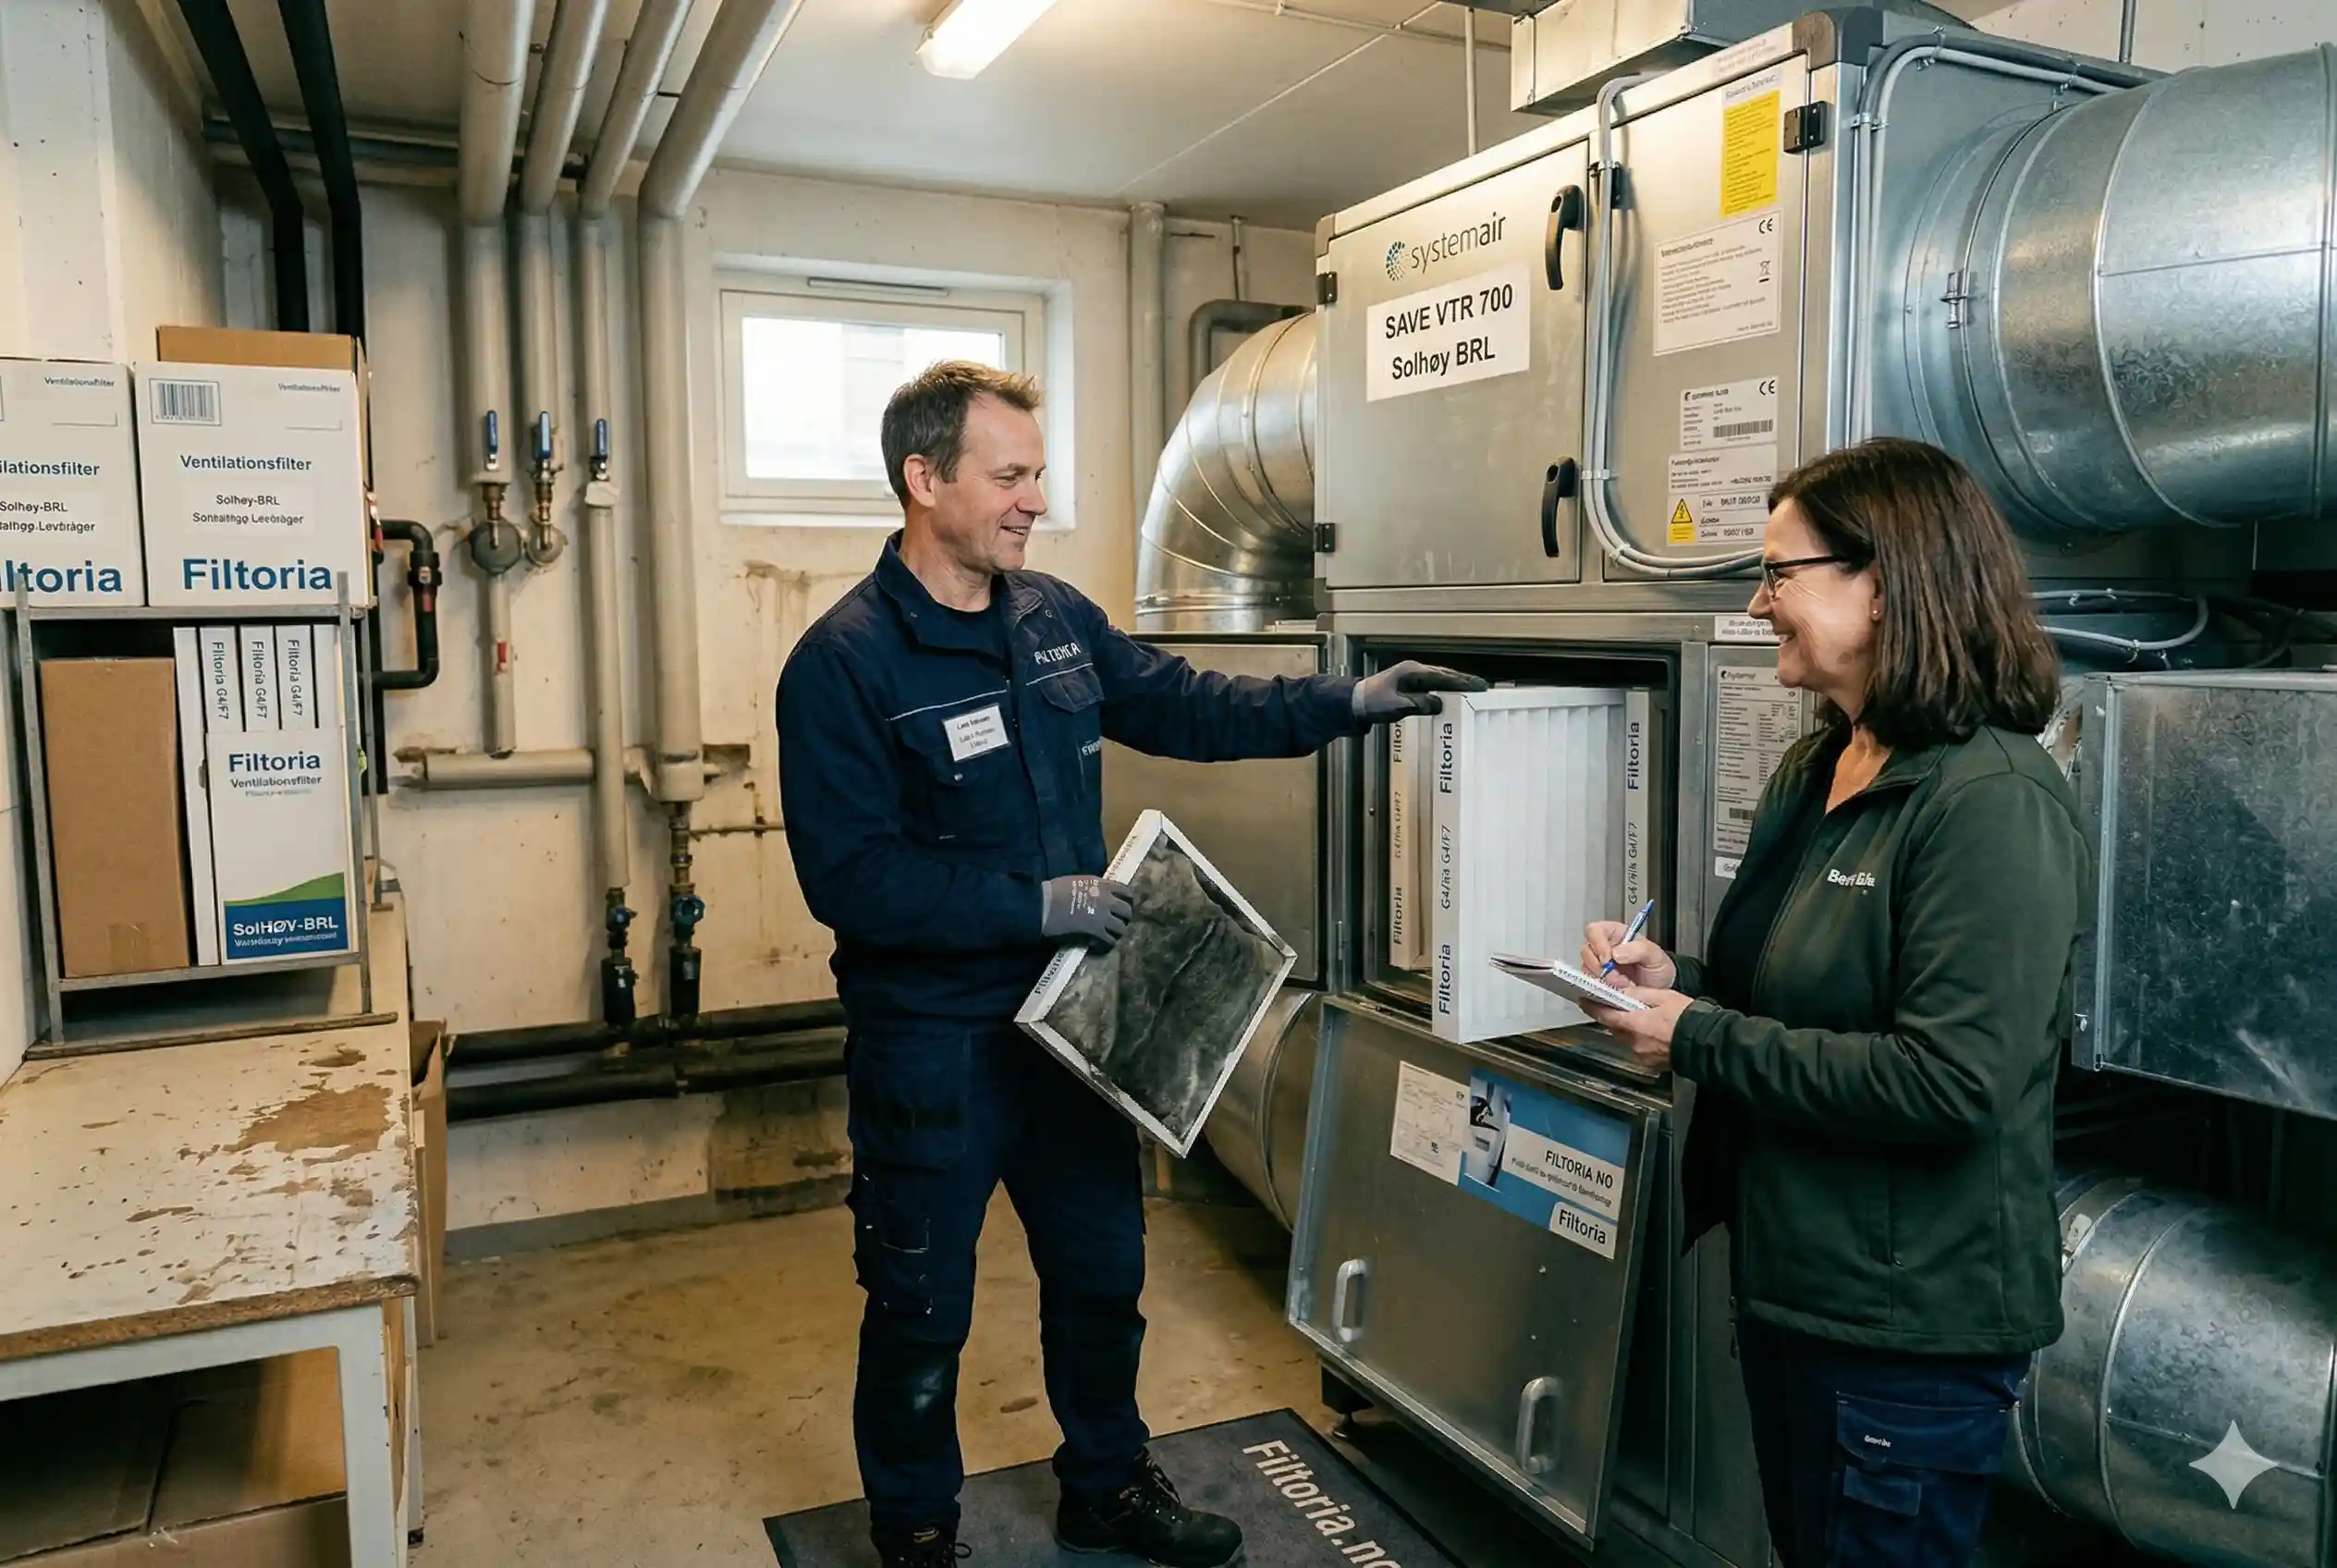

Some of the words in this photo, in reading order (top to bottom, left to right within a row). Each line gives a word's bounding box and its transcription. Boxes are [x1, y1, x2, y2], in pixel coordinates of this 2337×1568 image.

[1411, 212, 1506, 274] systemair
[1385, 306, 1431, 339] SAVE
[1436, 294, 1474, 326] VTR
[1479, 283, 1513, 315] 700
[1392, 351, 1450, 380] Solhøy
[1456, 336, 1496, 366] BRL
[180, 455, 312, 471] Ventilationsfilter
[0, 559, 123, 593] ltoria
[183, 558, 333, 591] Filtoria
[228, 751, 321, 773] Filtoria
[1439, 722, 1453, 794] Filtoria
[1627, 722, 1640, 790] Filtoria
[1438, 944, 1451, 1015] Filtoria
[1545, 1150, 1593, 1182] FILTORIA
[1596, 1170, 1613, 1189] NO
[1559, 1208, 1607, 1244] Filtoria
